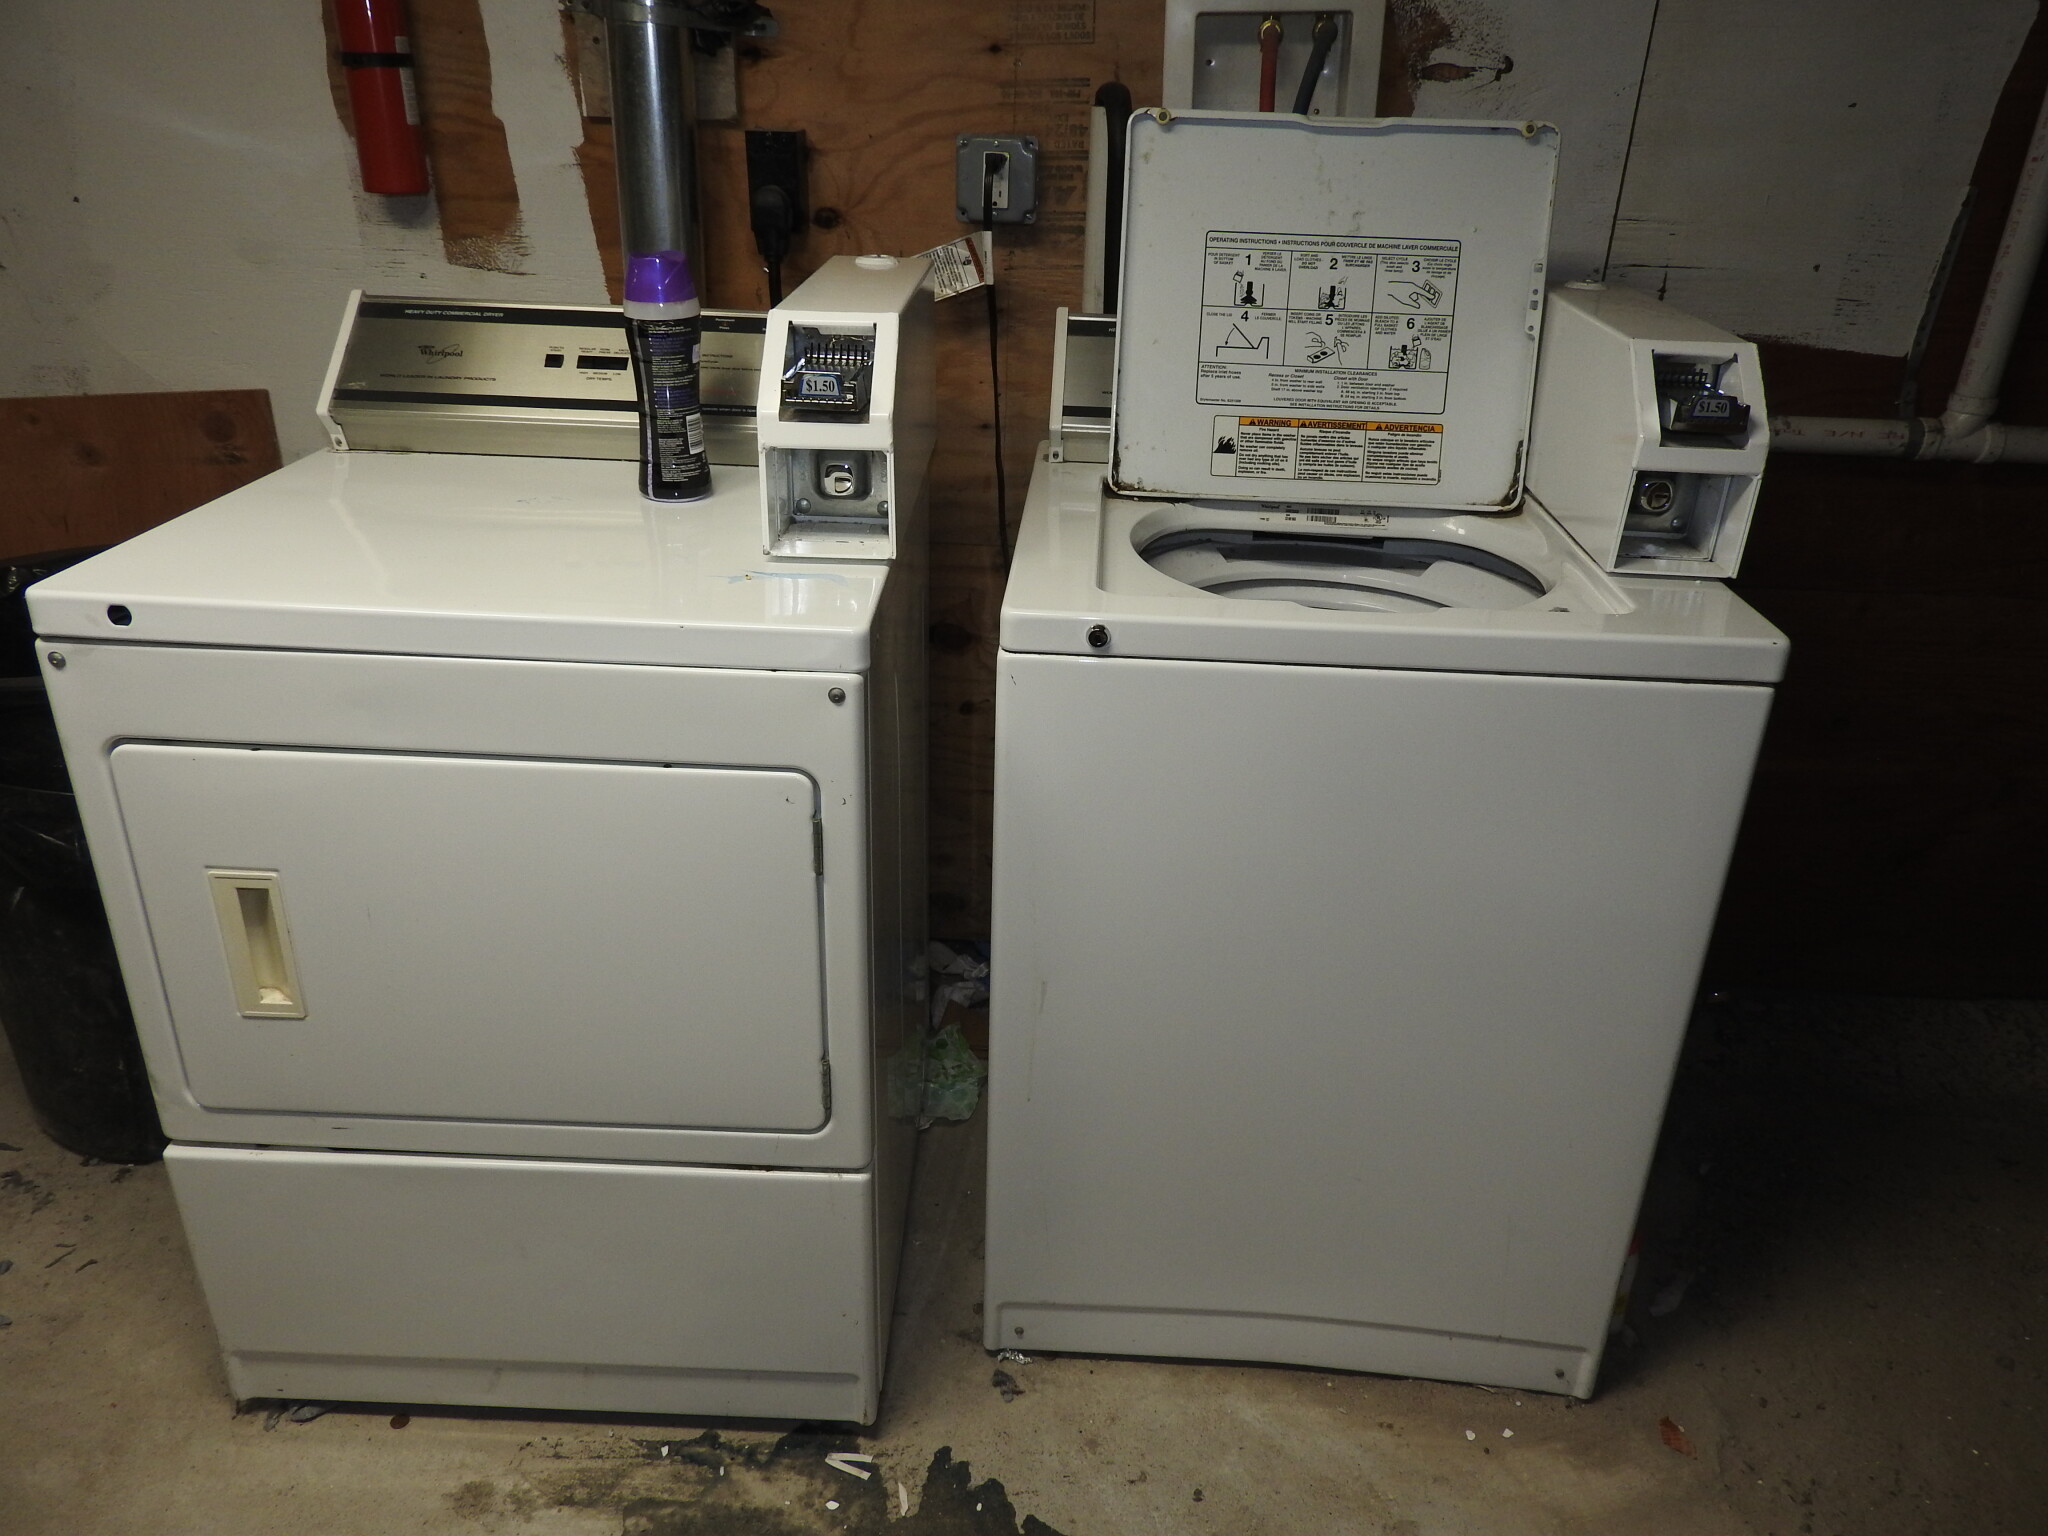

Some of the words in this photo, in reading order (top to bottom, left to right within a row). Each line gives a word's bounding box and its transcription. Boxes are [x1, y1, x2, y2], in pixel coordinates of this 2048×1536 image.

[1245, 254, 1251, 266] 1
[1329, 258, 1338, 270] 2
[1412, 260, 1421, 272] 3
[1240, 310, 1250, 322] 4
[1325, 314, 1334, 325] 5
[1406, 318, 1415, 329] 6
[418, 345, 463, 358] Whirlpool
[806, 378, 835, 392] $1.50
[1698, 401, 1727, 413] $1.50
[1308, 421, 1366, 430] AVERTISSEMENT
